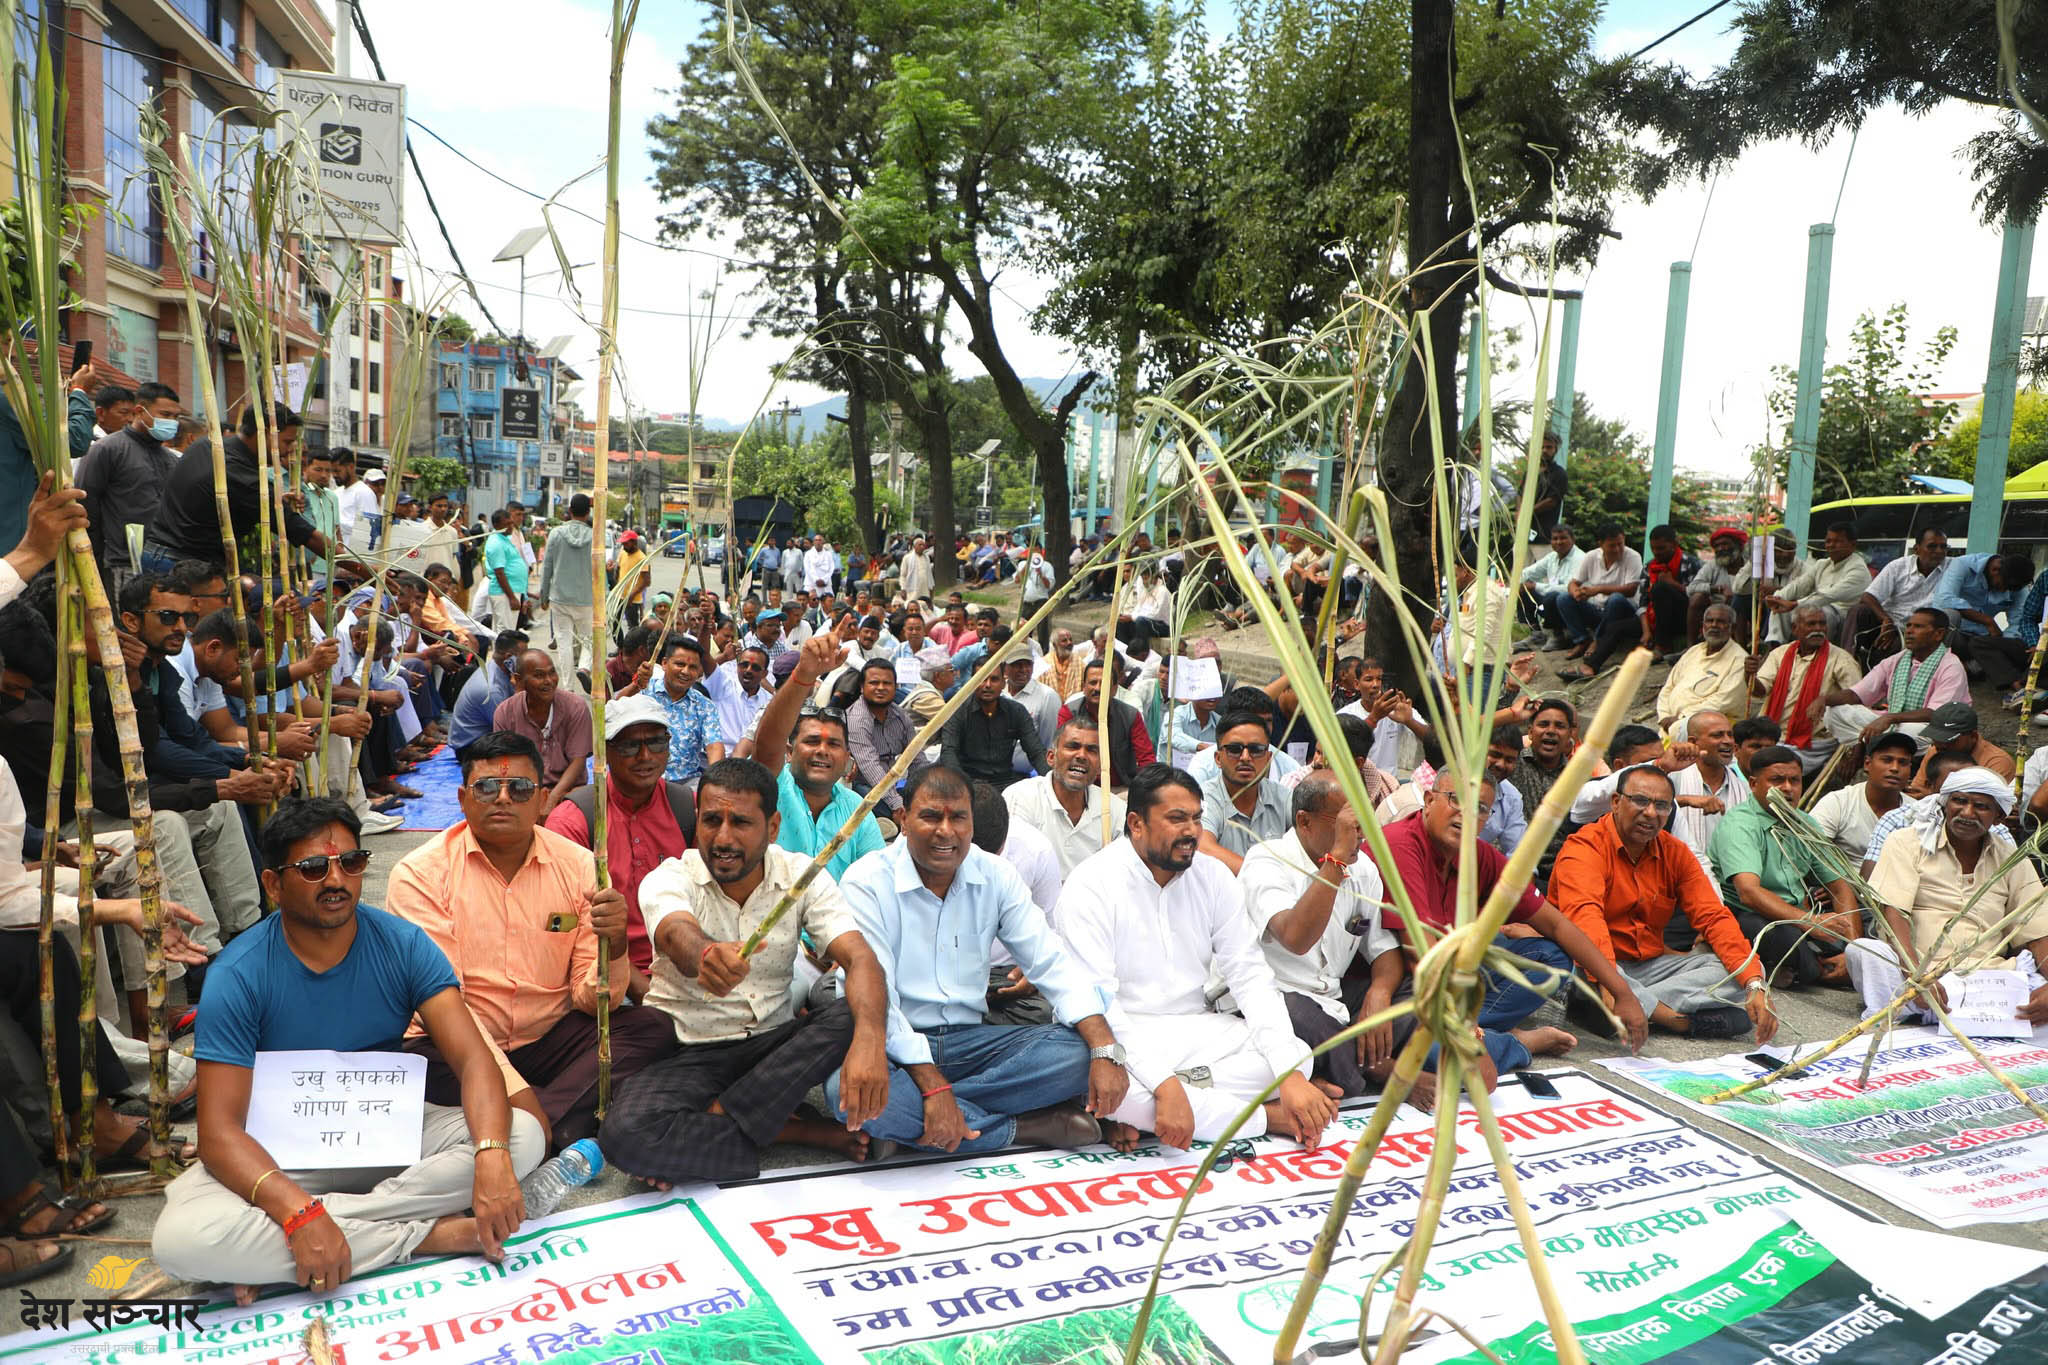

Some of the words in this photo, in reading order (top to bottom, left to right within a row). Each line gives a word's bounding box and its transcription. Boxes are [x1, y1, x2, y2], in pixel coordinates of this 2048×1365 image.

[356, 172, 393, 185] GURU
[292, 1070, 327, 1093] उखु
[336, 1066, 409, 1093] कृषकको
[293, 1096, 348, 1117] शोषण
[320, 1131, 346, 1147] गर
[954, 1162, 1026, 1180] उखु
[900, 1165, 1214, 1234] उत्पादक
[927, 1285, 1024, 1328] प्रति
[1661, 1281, 1748, 1321] किसान
[1739, 1249, 1788, 1288] एक
[375, 1259, 687, 1361] आन्दोलन
[614, 1287, 748, 1336] आएको
[1768, 1293, 1904, 1365] किसानलाई
